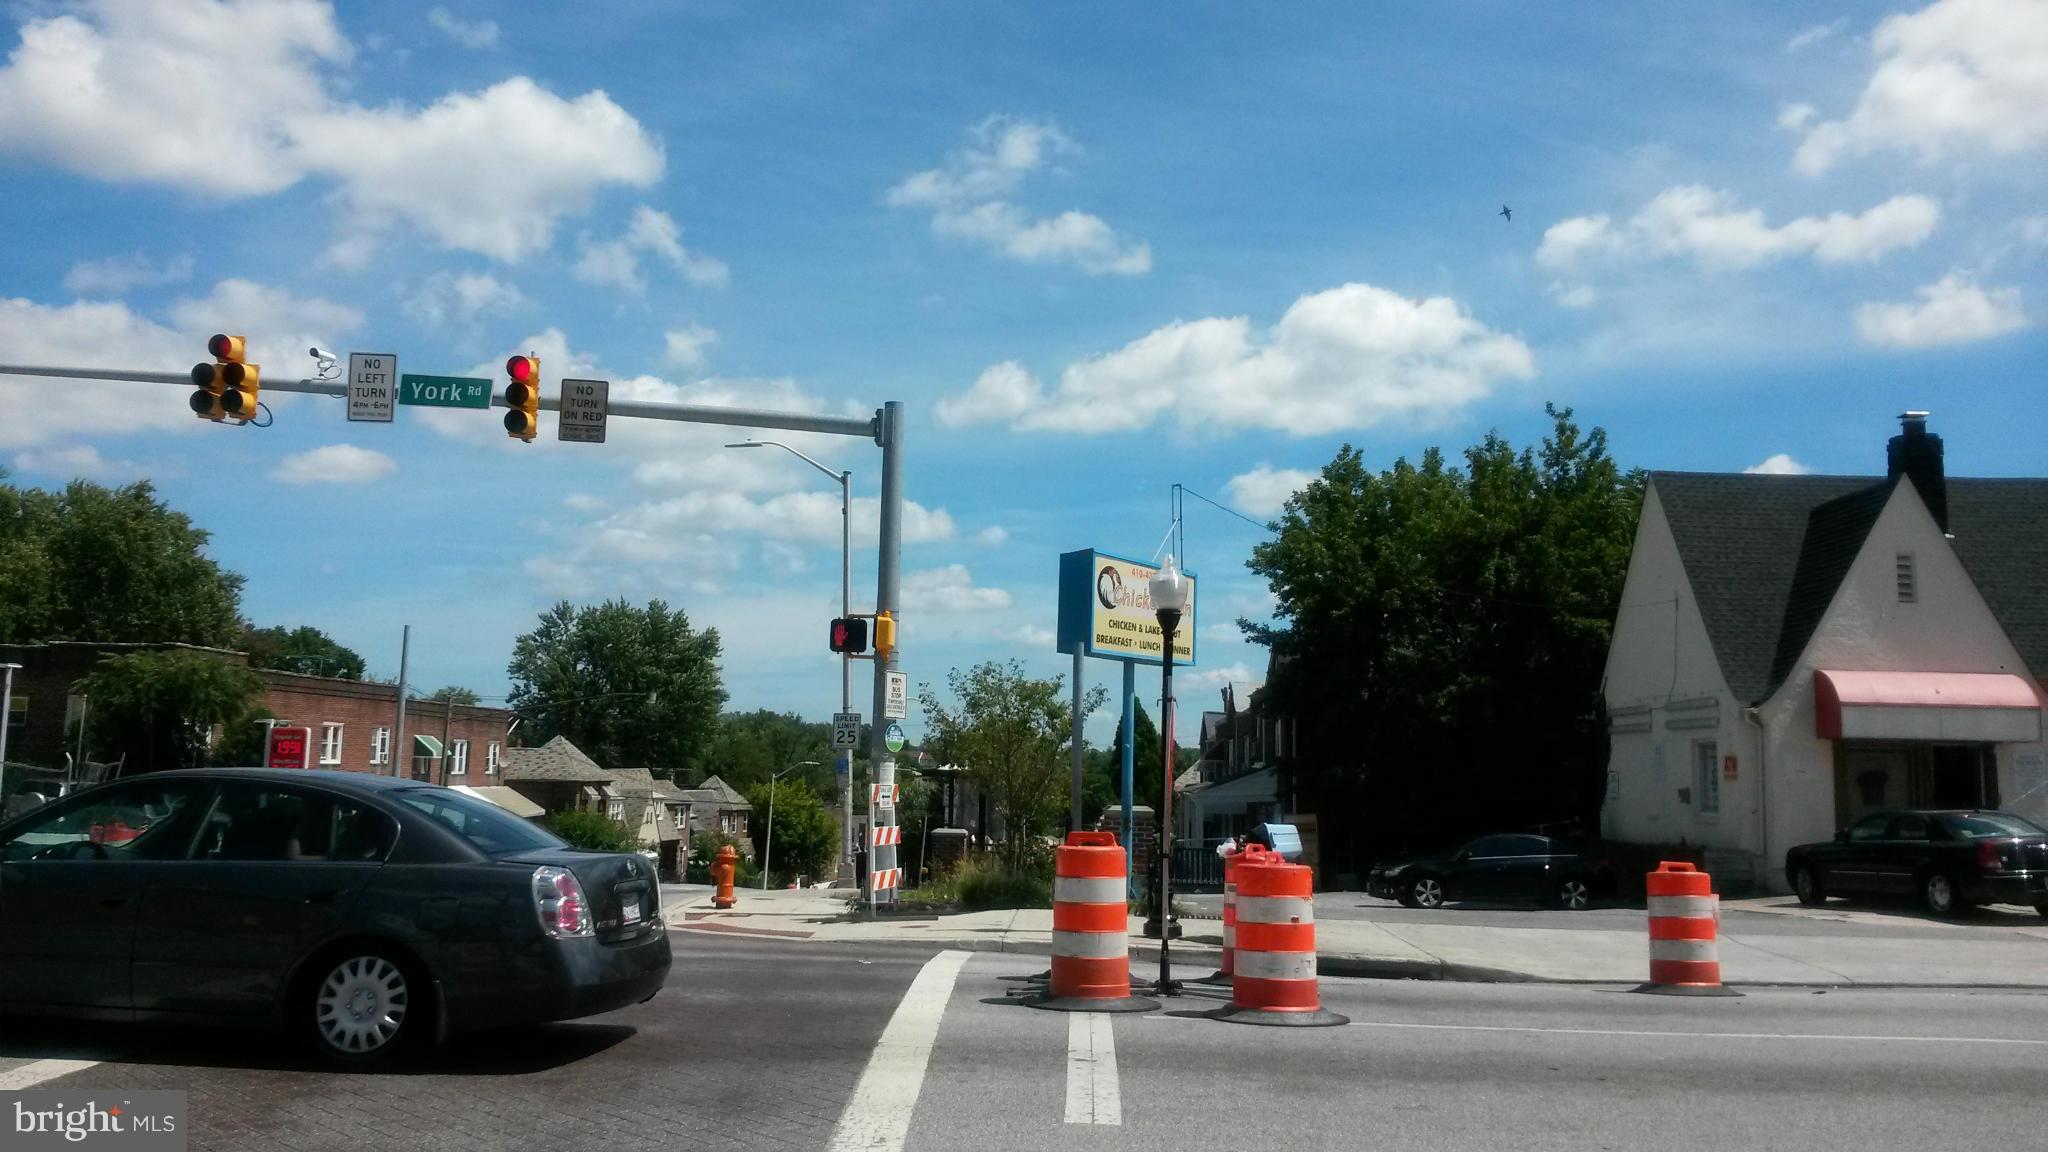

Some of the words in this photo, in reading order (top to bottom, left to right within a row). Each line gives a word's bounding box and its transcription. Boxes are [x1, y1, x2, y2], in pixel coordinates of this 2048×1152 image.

[364, 359, 381, 369] NO
[357, 373, 386, 384] LEFT
[355, 387, 386, 398] TURN
[411, 382, 462, 401] York
[467, 386, 482, 396] Rd
[576, 385, 594, 396] NO
[571, 398, 598, 409] TURN
[564, 410, 578, 420] ON
[582, 411, 603, 422] RED
[1108, 619, 1137, 633] CHICKEN
[1144, 625, 1161, 636] LAKE
[1095, 633, 1133, 648] BREAKFAST
[1139, 640, 1161, 652] LUNCH
[836, 731, 856, 743] 25
